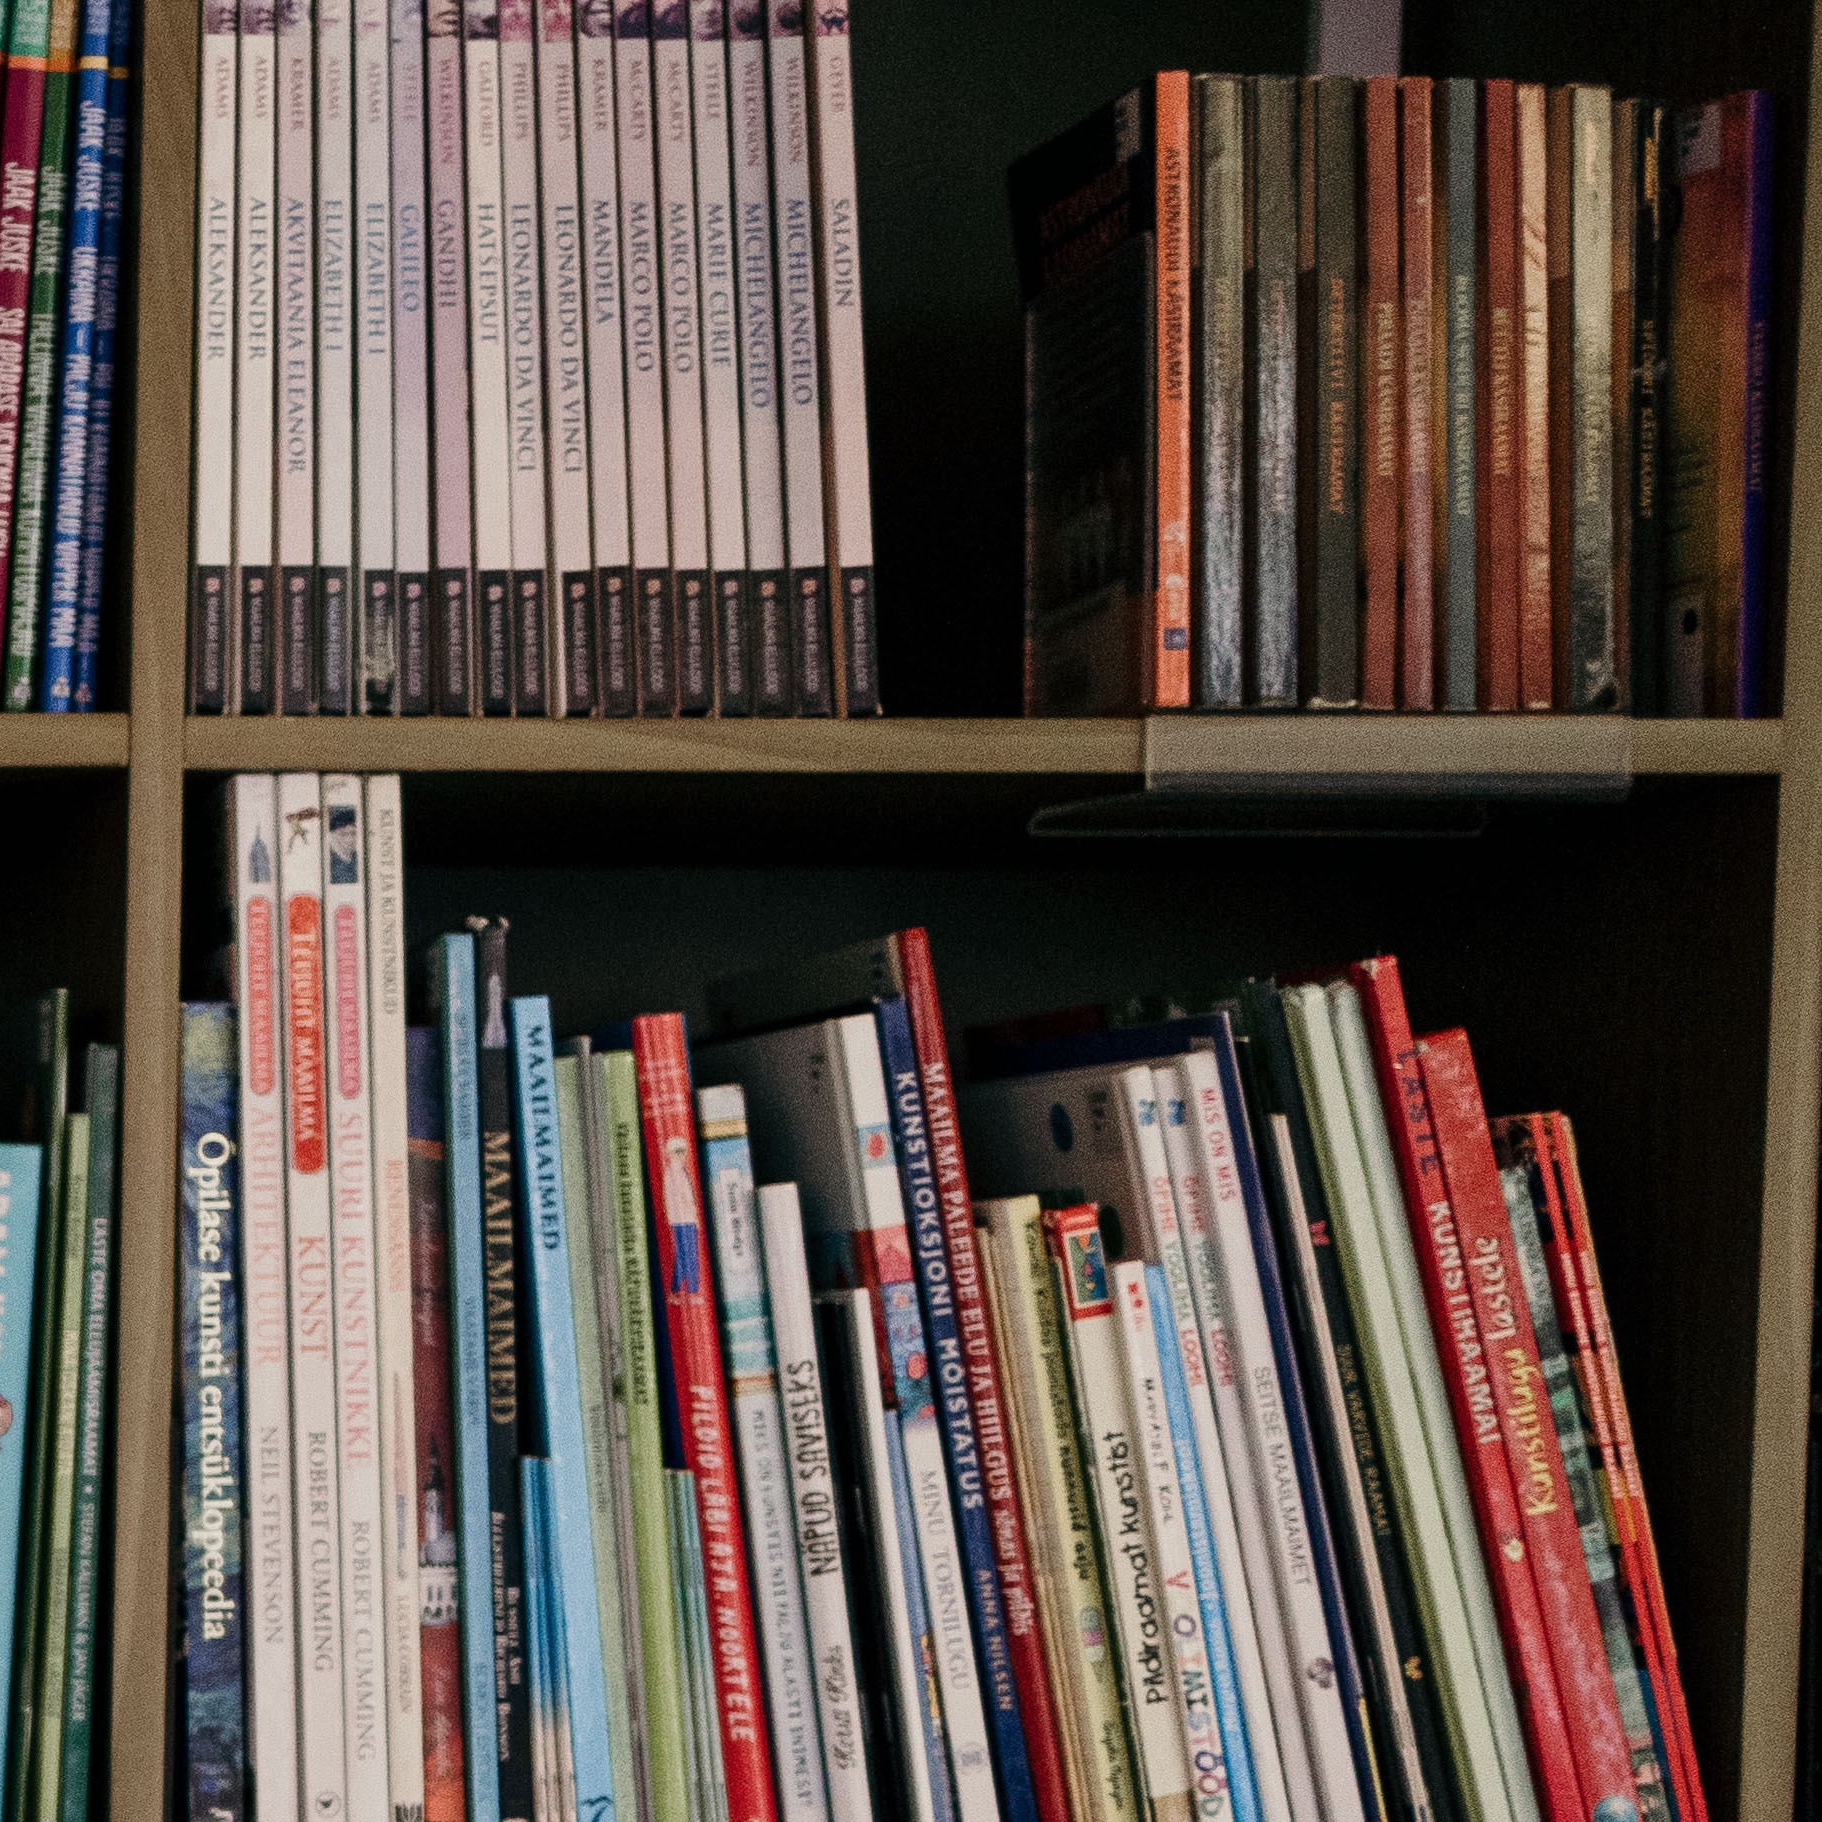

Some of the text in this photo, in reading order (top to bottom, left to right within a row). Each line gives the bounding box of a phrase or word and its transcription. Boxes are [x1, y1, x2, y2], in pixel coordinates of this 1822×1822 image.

[207, 196, 229, 360] ALEKSANDER
[246, 196, 269, 360] ALEKSANDER
[365, 202, 387, 339] ELIZABETH
[400, 204, 422, 313] GALILEO
[436, 200, 458, 309] GANDHI
[511, 204, 539, 474] LEONARDO DA VINCI
[554, 204, 583, 475] LEONARDO DA VINCI
[592, 200, 616, 325] MANDELA
[629, 200, 655, 372] MARCO POLO
[667, 201, 693, 374] MARCO POLO
[706, 202, 731, 368] MARIE CURIE
[742, 201, 770, 409] MICHELANGELO
[786, 198, 814, 406] MICHELANGELO
[829, 198, 854, 307] SALADIN
[527, 1024, 561, 1251] MAAILMAIMED
[1201, 1088, 1235, 1202] MIS ON MIS
[1395, 1048, 1439, 1177] LASTE
[249, 1108, 282, 1366] ARHITEKTUUR
[296, 1235, 329, 1360] KUNST
[338, 1112, 373, 1470] SUURI KUNSTNIKKE
[483, 1130, 517, 1425] MAAILMAIMED
[894, 1070, 984, 1511] KUNSTIOKSJONI MÕISTATUS
[923, 1061, 1011, 1502] MAAILMA PALEEDE ELU JA HIILGUS
[189, 1130, 237, 1641] Õpilase kunsti entsüklopeedia
[785, 1360, 830, 1480] SAVISEKS
[1474, 1236, 1558, 1516] Kunstilugu lastele
[258, 1425, 284, 1644] NEIL STEVENSON
[306, 1431, 333, 1671] ROBERT CUMMING
[919, 1469, 942, 1537] MINU
[1253, 1366, 1279, 1437] SEITSE
[1266, 1441, 1311, 1587] MAAILMAIMET
[352, 1521, 376, 1761] ROBERT CUMMING
[976, 1568, 1013, 1712] ANNA NILSEN
